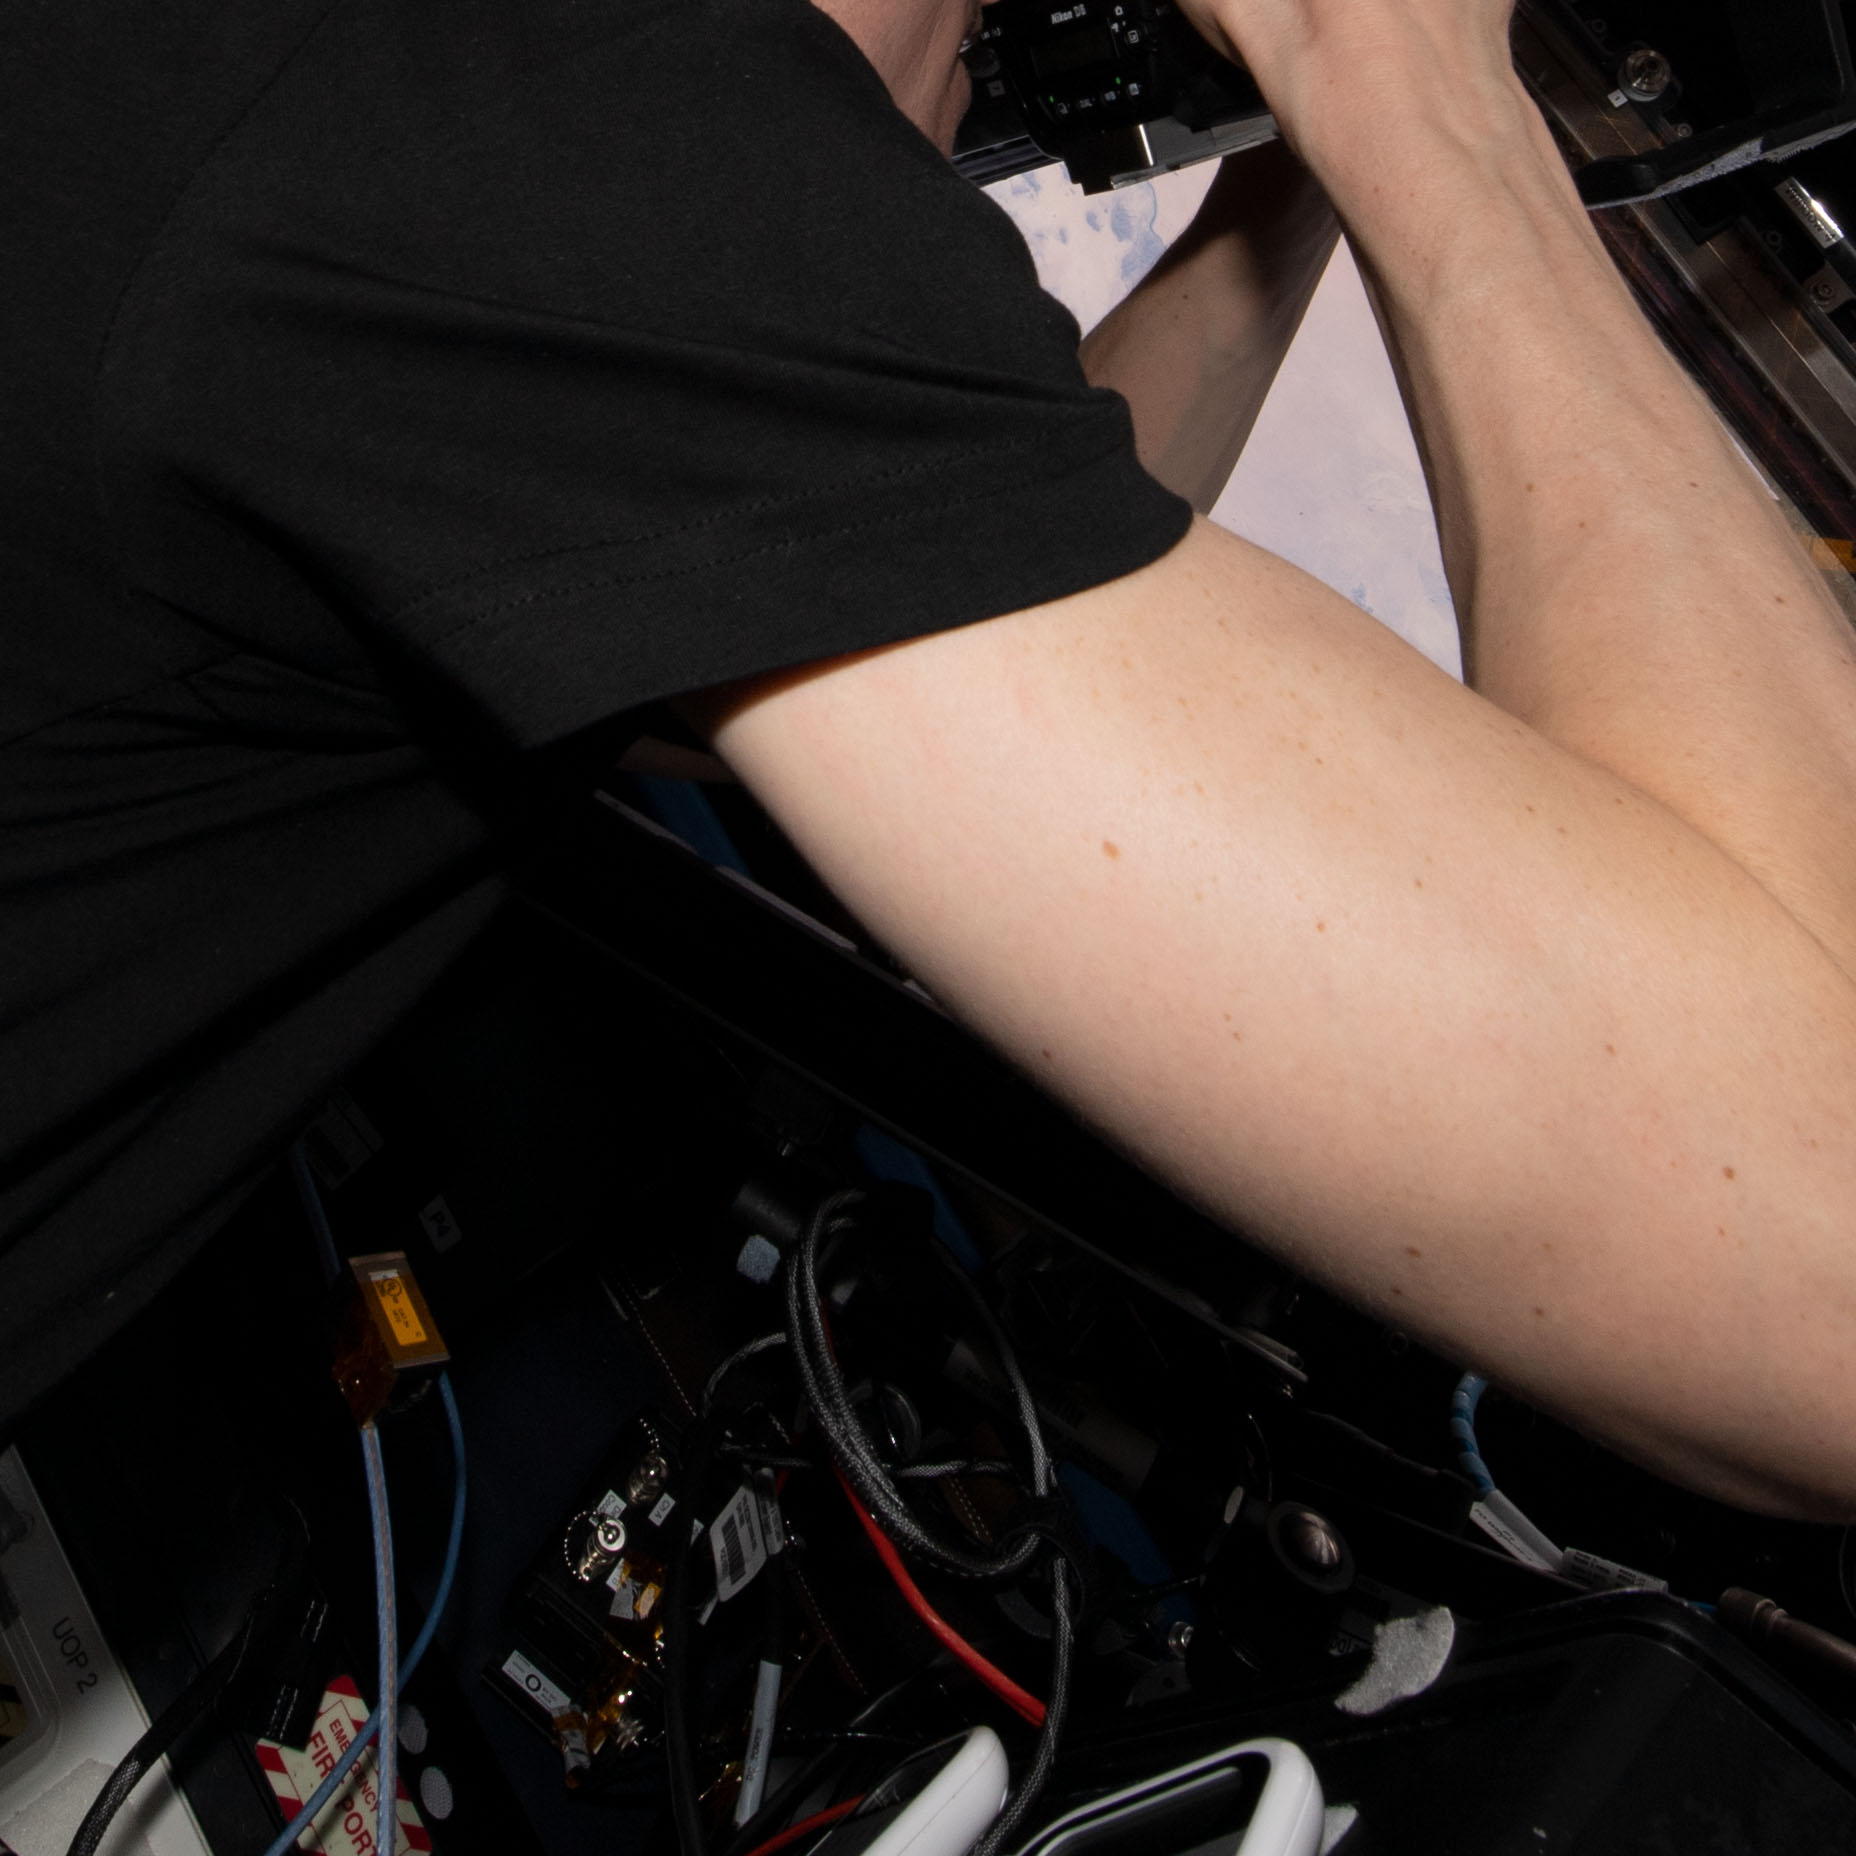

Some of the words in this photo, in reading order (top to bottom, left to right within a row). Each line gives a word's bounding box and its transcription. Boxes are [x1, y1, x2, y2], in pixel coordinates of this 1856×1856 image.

[1049, 9, 1073, 25] Nikon
[47, 1615, 92, 1674] UOP
[73, 1670, 101, 1694] 2
[302, 1729, 346, 1792] FIR
[327, 1718, 382, 1813] EMEGENCY
